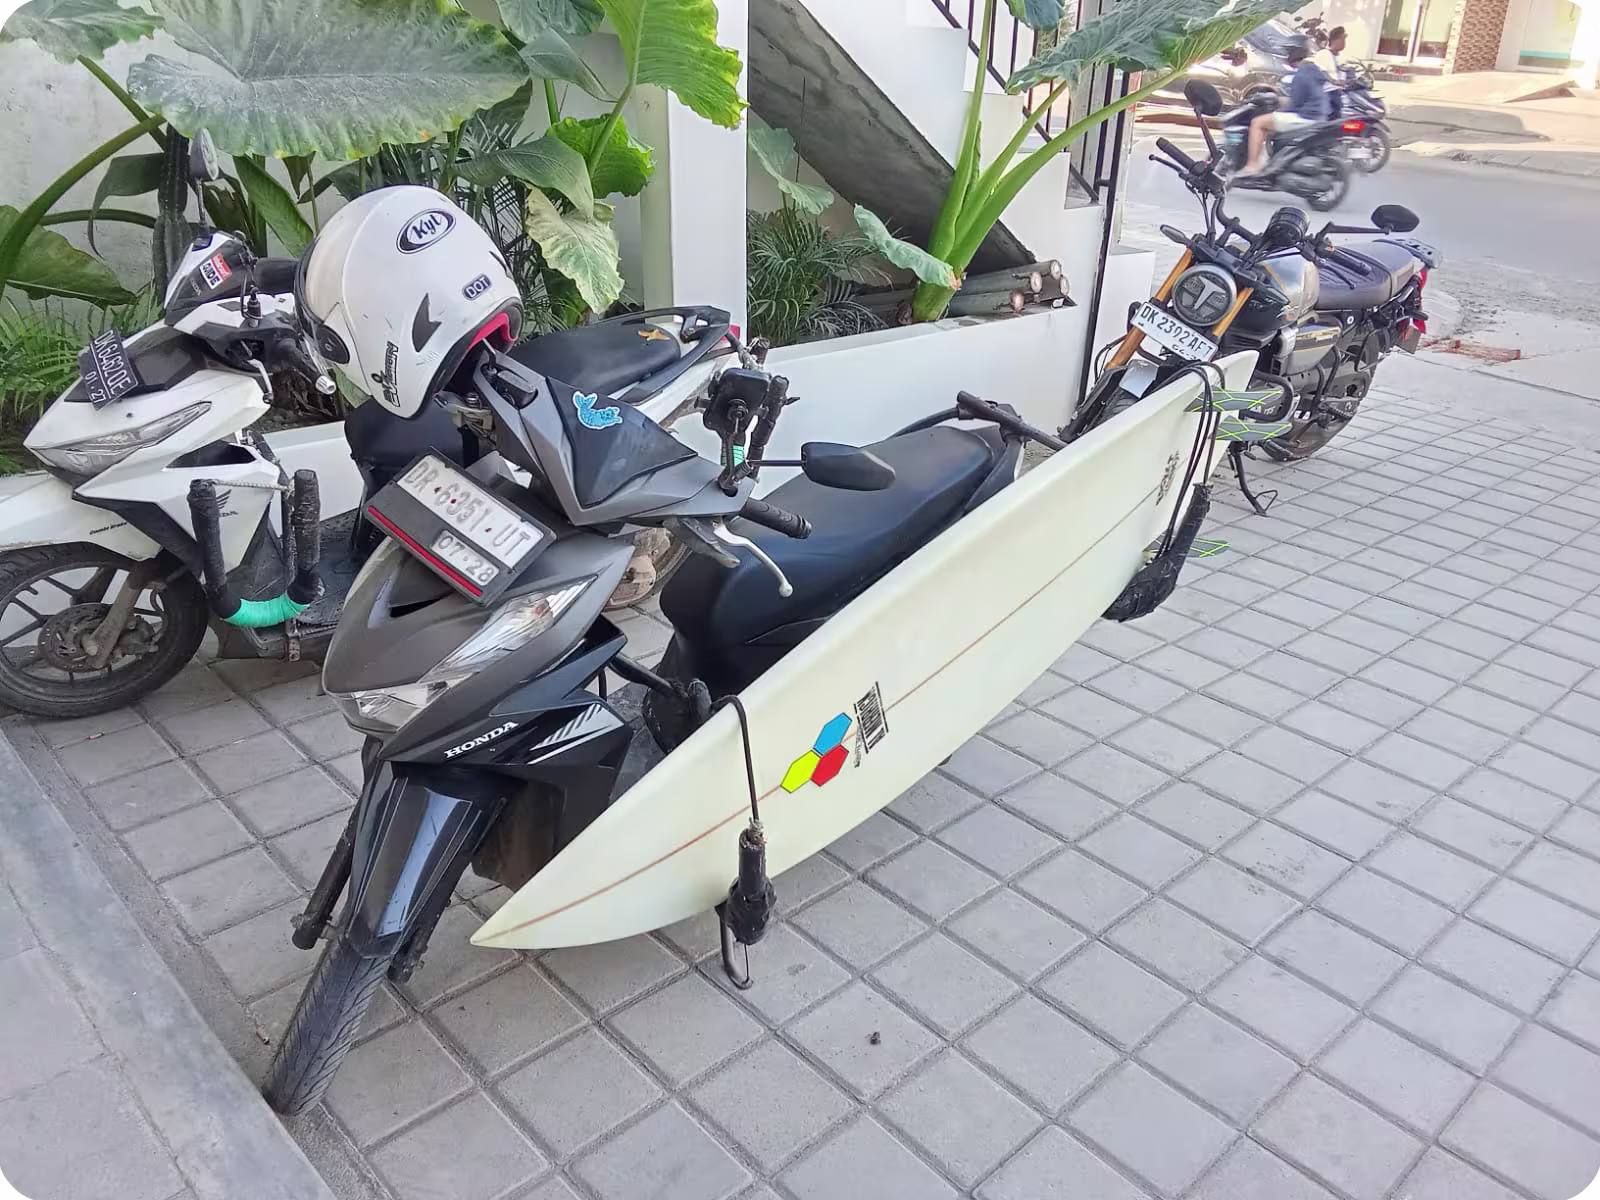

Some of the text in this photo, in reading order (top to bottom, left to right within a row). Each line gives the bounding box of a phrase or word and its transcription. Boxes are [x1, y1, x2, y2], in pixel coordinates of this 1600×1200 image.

[466, 277, 489, 298] DOT
[1140, 305, 1159, 325] DK
[403, 461, 532, 557] DR 6351 UT
[444, 721, 519, 759] HONDA
